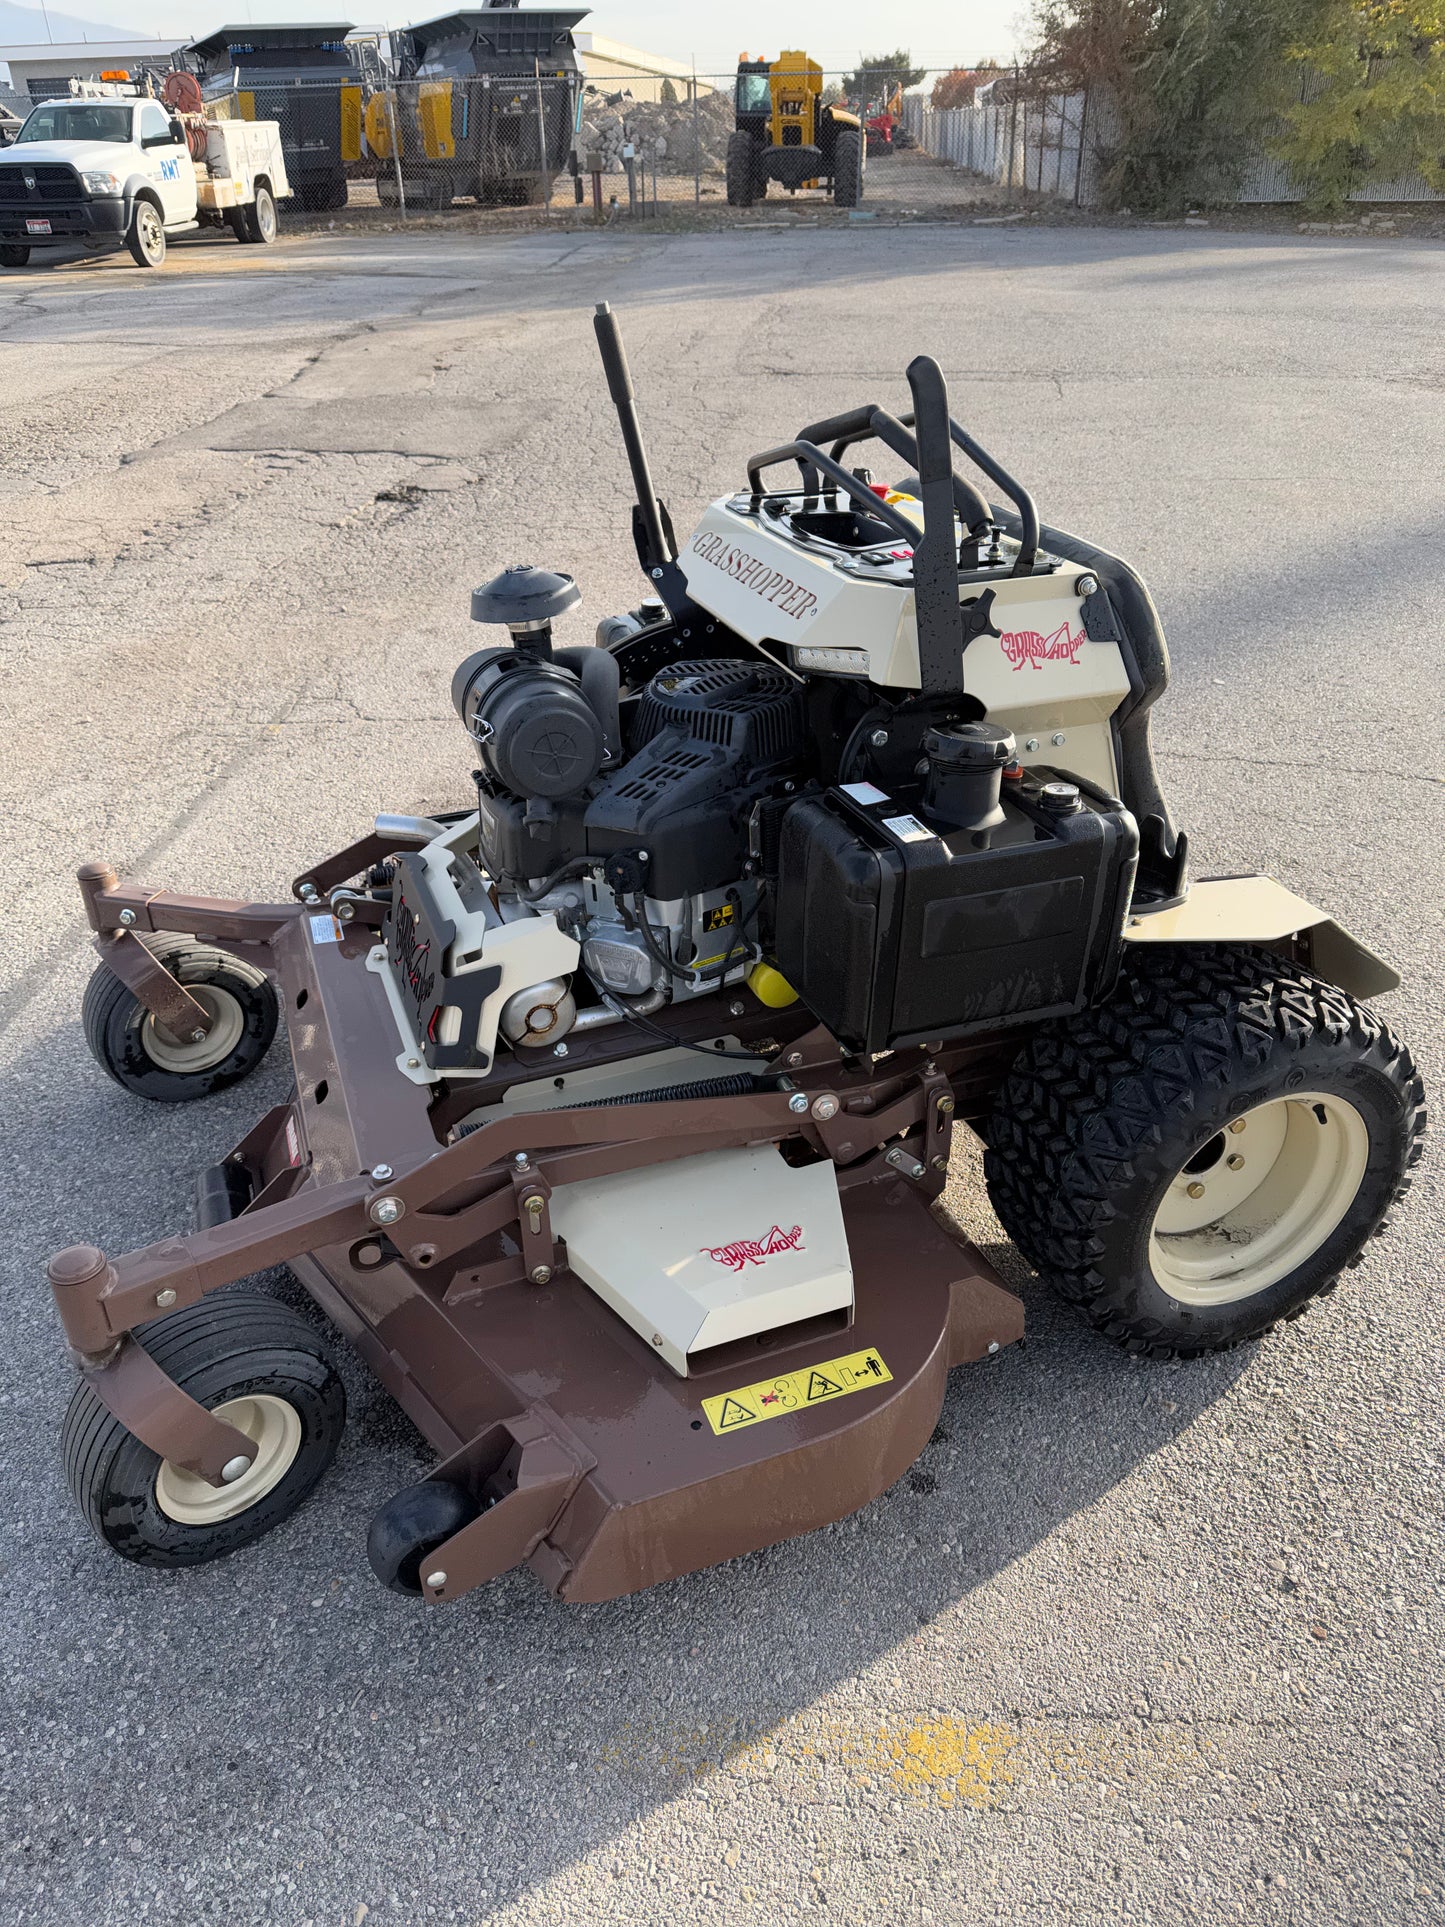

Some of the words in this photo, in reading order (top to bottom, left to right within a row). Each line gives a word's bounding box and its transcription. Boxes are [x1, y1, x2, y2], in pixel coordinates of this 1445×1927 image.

[160, 159, 180, 181] RMT
[693, 531, 817, 620] GRASSHOPPER
[1000, 622, 1087, 670] GRASSHOPPER
[704, 1225, 803, 1270] GRASSHOPPER
